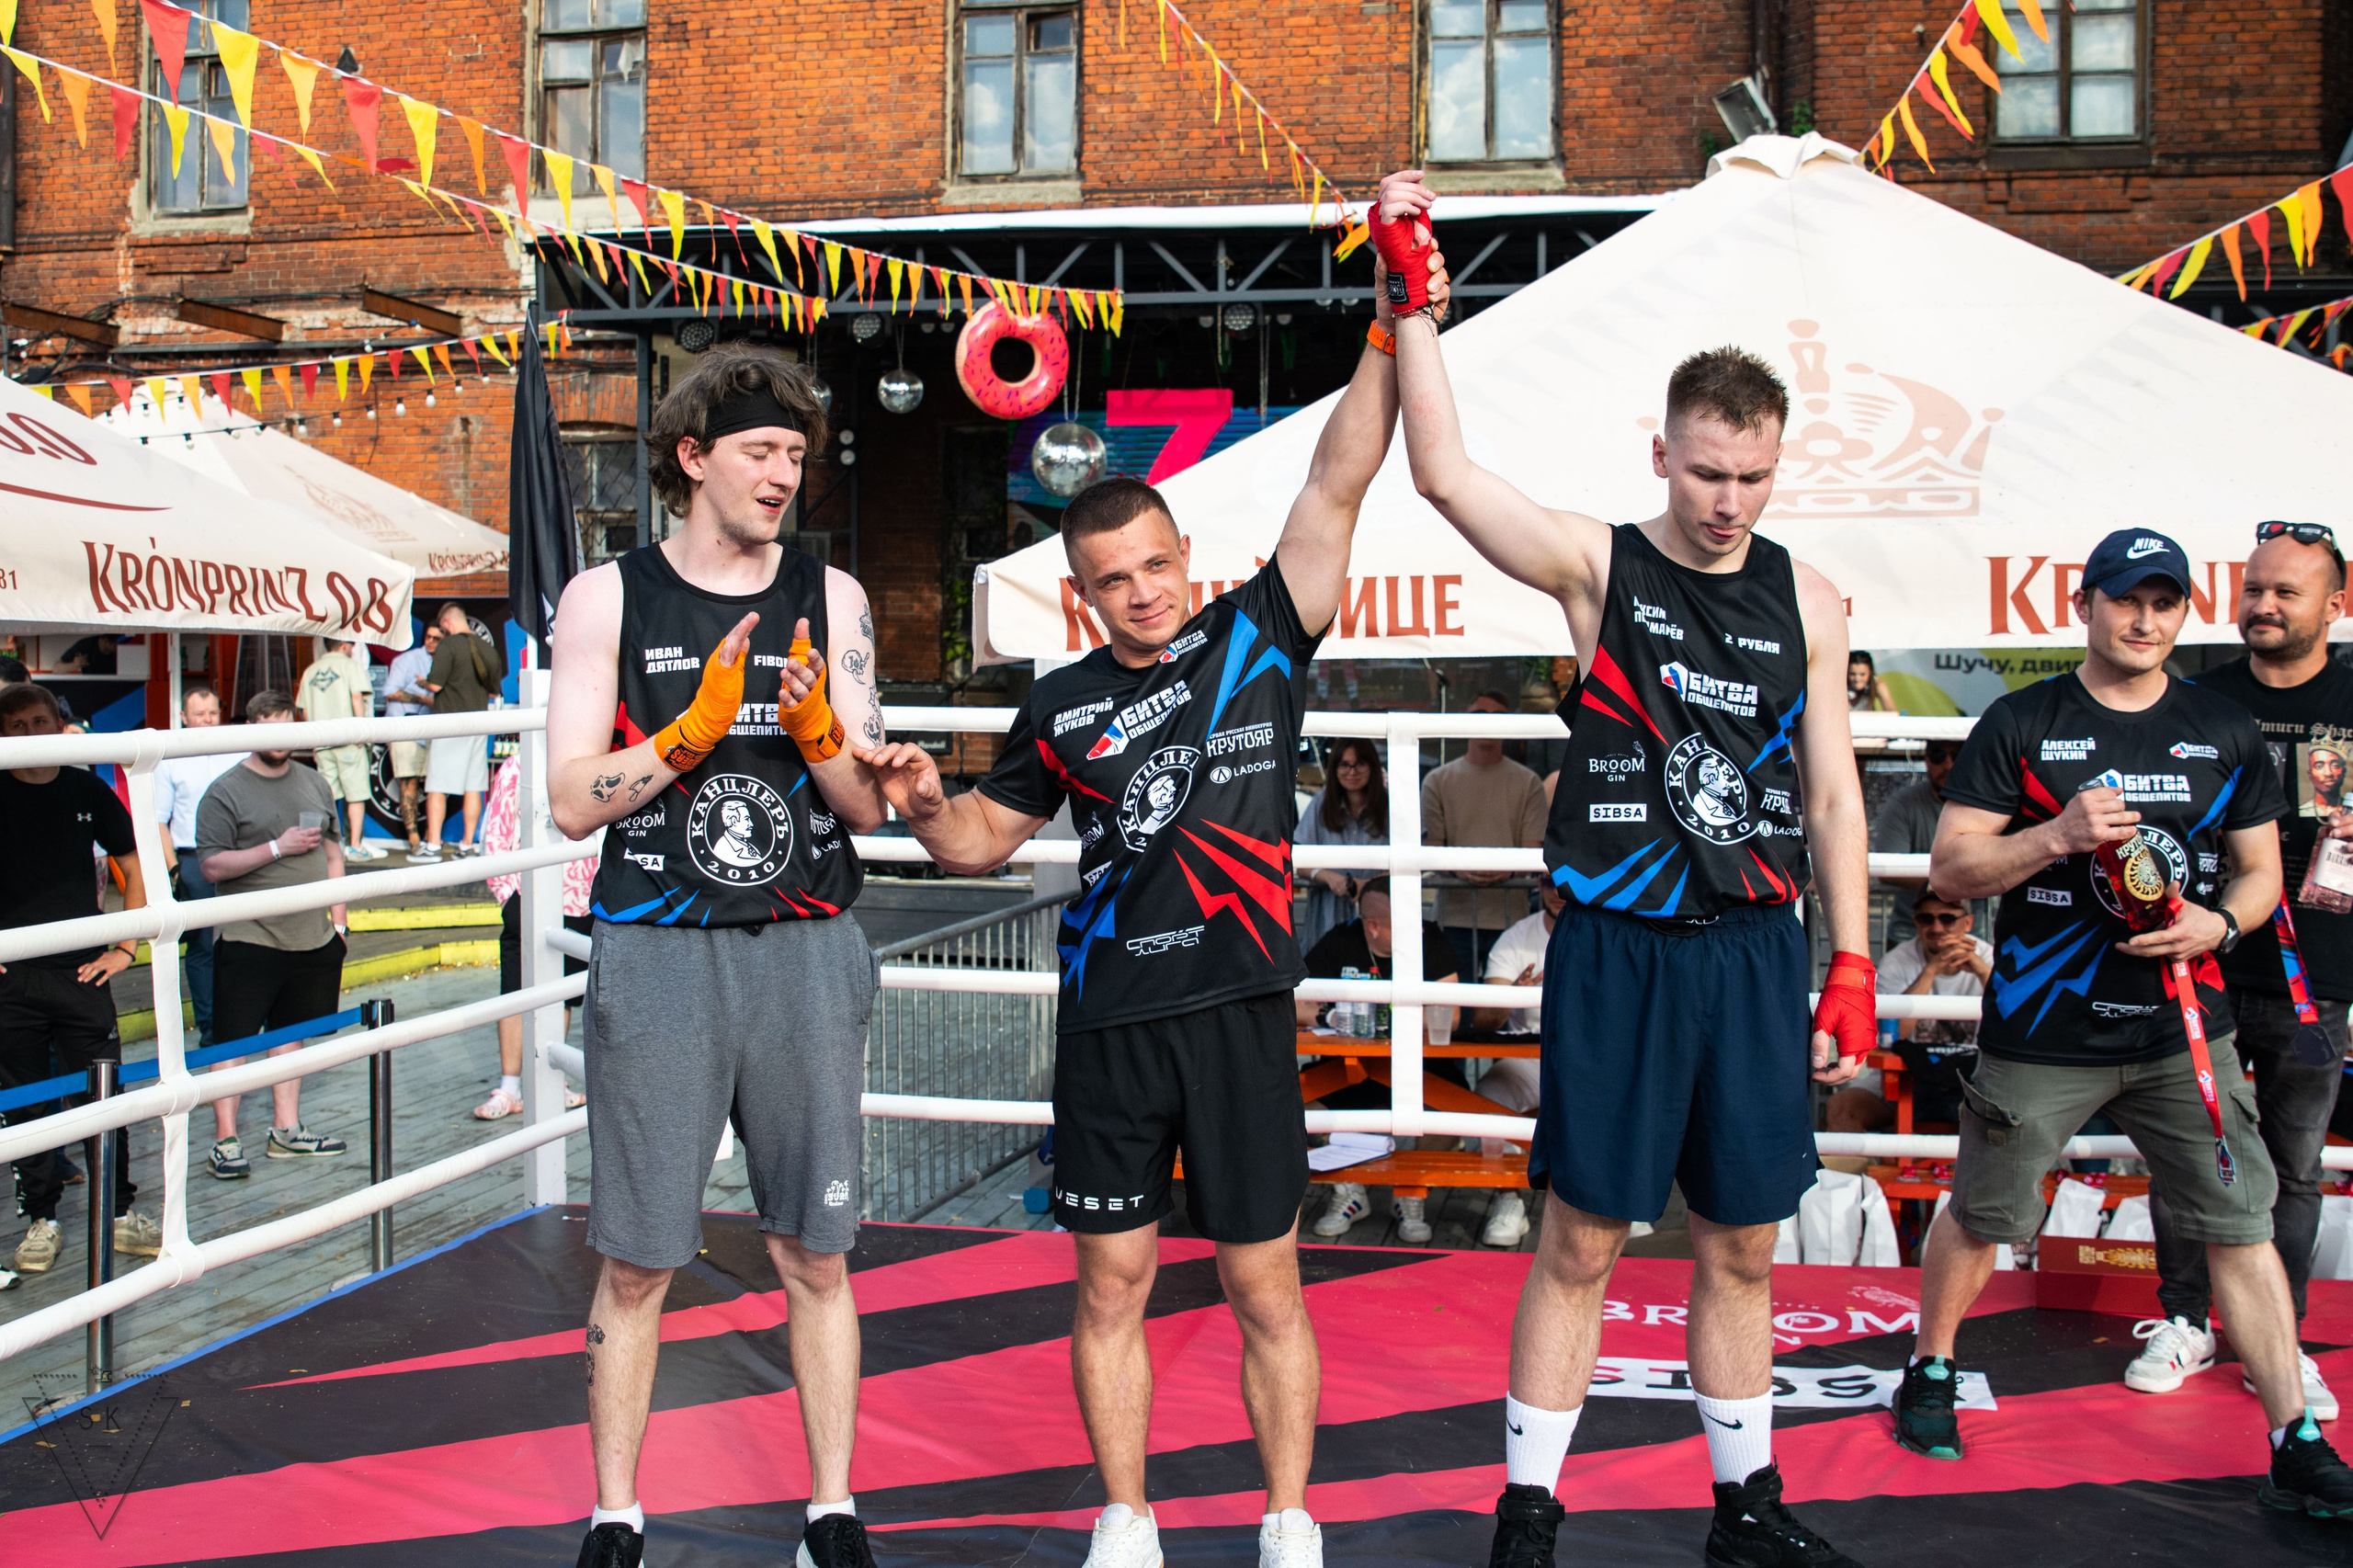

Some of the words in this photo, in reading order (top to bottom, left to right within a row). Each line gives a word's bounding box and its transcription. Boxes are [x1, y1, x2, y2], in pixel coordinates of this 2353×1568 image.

[2133, 538, 2165, 550] NIKE
[1175, 630, 1206, 650] БИТВА
[1738, 637, 1780, 654] РУБЛЯ
[645, 646, 683, 660] ИВАН
[645, 657, 700, 674] ДЯТЛОВ
[1934, 653, 2014, 675] Шучу,
[1688, 671, 1758, 705] БИТВА
[736, 703, 779, 723] ИТВ
[1054, 697, 1114, 726] ДМИТРИЙ
[1120, 679, 1188, 729] БИТВА
[1053, 716, 1096, 737] ЖУКОВ
[1206, 728, 1274, 757] КРУТОЯР
[2041, 737, 2096, 750] АЛЕКСЕЙ
[1588, 757, 1645, 773] BROOM
[2123, 775, 2190, 792] БИТВА
[691, 778, 790, 839] КАНЦЛЕРЪ
[1593, 808, 1643, 818] SIBSA
[1686, 813, 1751, 839] 2010
[707, 860, 776, 880] 2010
[2029, 890, 2069, 903] SIBSA
[1602, 1300, 1920, 1335] BROM
